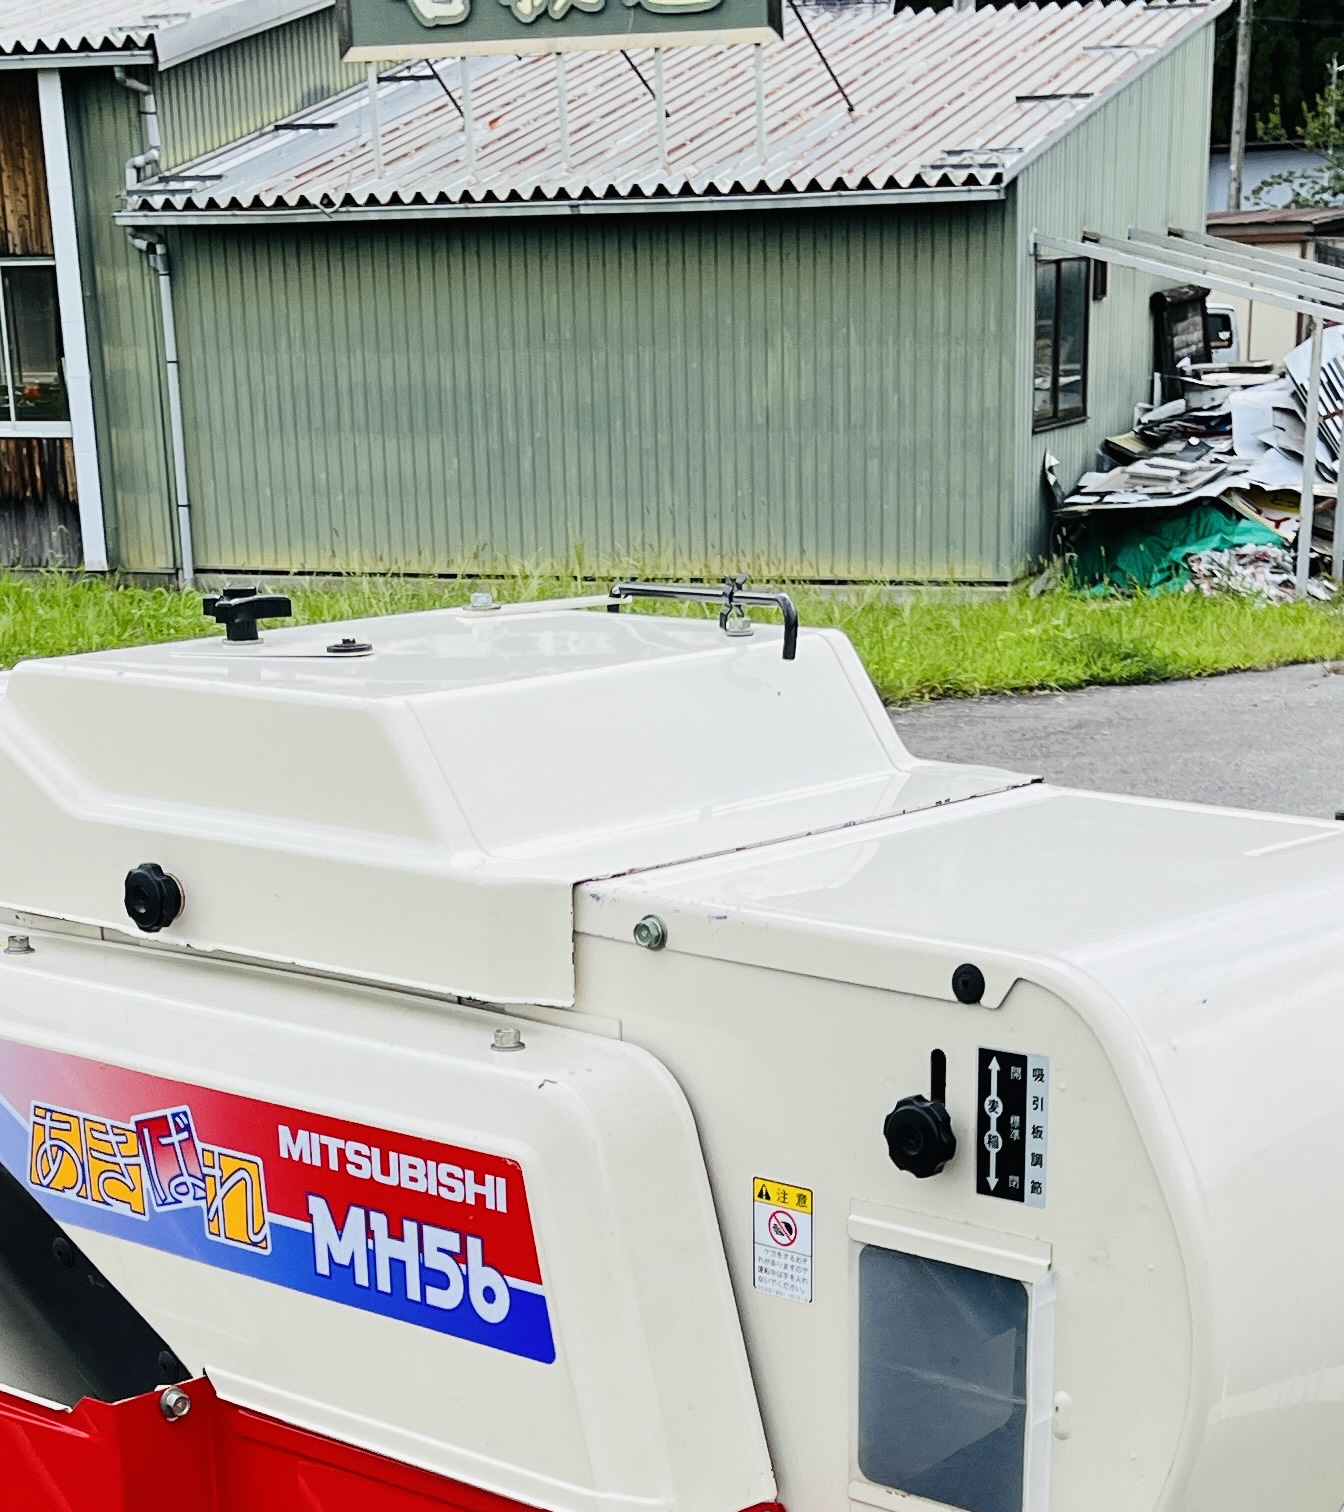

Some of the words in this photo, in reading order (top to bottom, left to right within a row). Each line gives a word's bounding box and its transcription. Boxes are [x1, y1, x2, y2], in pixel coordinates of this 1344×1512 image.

[27, 1100, 272, 1256] あきばれ
[277, 1124, 508, 1213] MITSUBISHI
[1030, 1067, 1045, 1196] 吸引板調節
[776, 1188, 808, 1209] 注意
